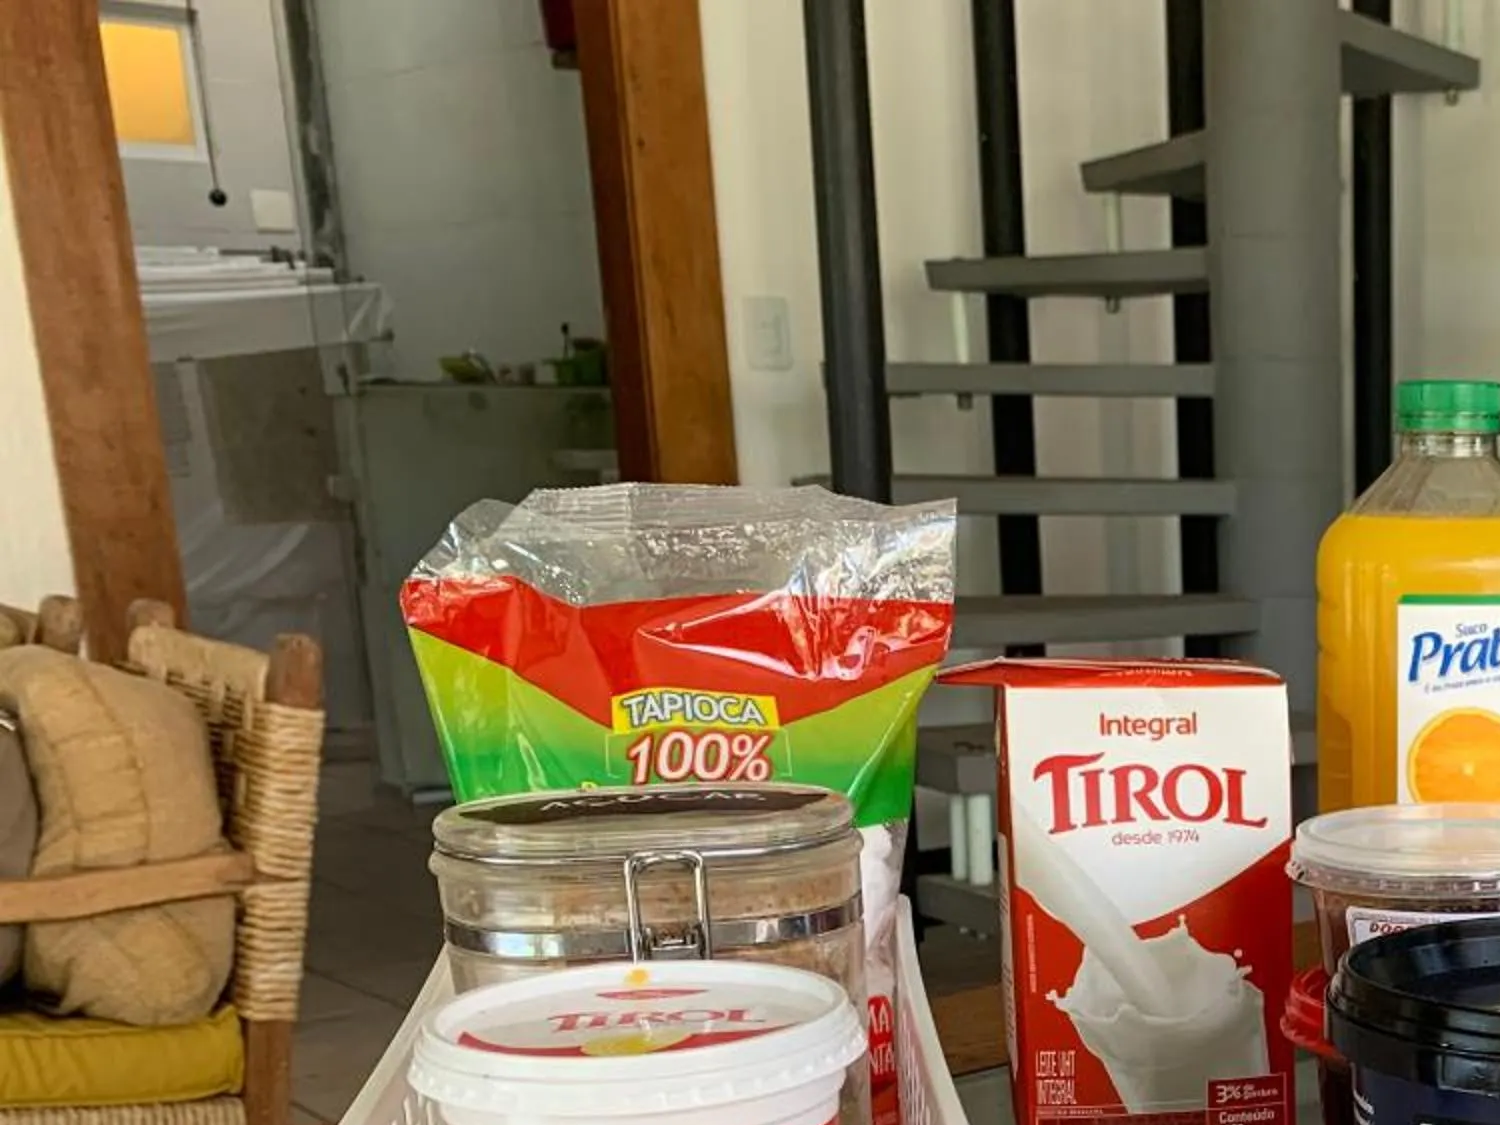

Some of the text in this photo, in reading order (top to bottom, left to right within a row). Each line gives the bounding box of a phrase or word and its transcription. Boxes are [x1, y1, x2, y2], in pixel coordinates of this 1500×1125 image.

[622, 693, 766, 727] TAPIOCA
[1099, 712, 1197, 741] Integral
[628, 730, 771, 784] 100%
[1032, 752, 1268, 835] TIROL
[1112, 828, 1200, 846] desde 1974
[547, 1009, 766, 1032] TIROL
